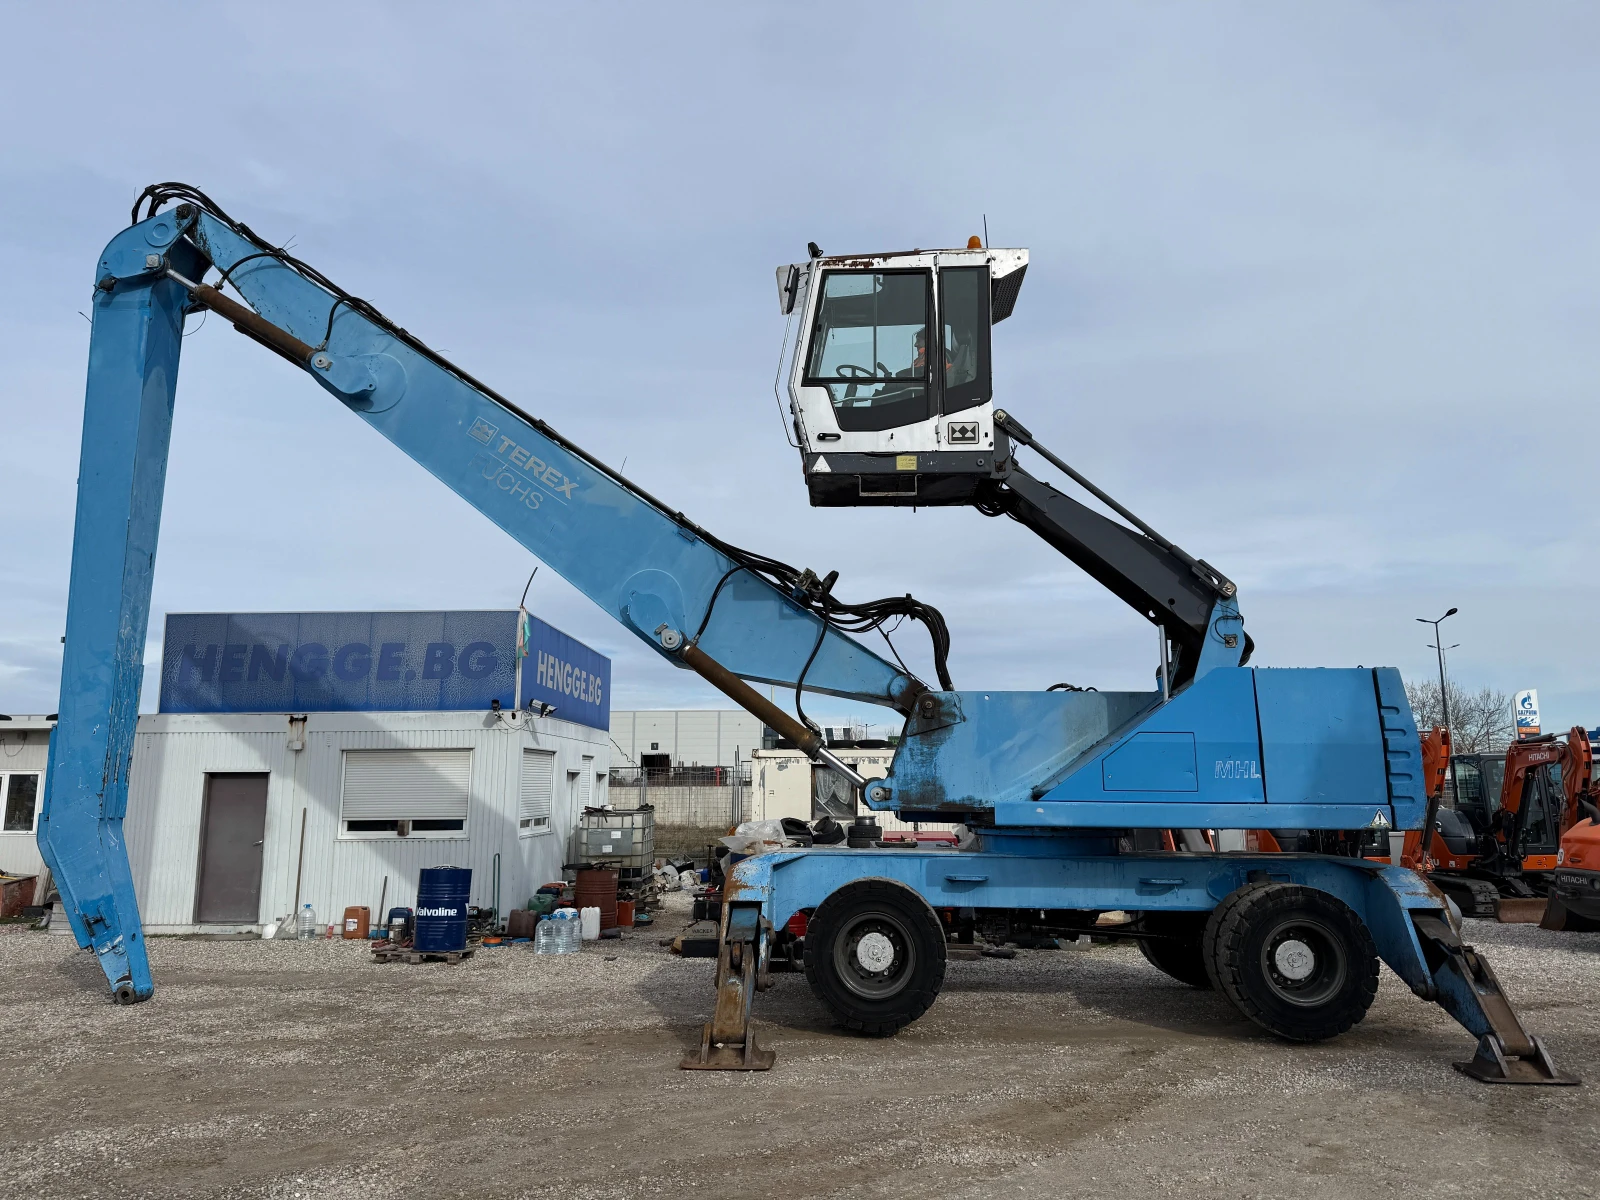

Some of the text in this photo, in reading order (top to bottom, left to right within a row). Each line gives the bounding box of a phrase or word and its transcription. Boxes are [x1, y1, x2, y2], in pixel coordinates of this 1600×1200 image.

[498, 435, 579, 500] TEREX
[178, 641, 498, 682] HENGGE.BG
[537, 649, 602, 706] HENGGE.BG
[1528, 751, 1550, 761] HITACHI
[1214, 760, 1261, 779] MHL
[1560, 874, 1588, 885] HITACHI
[416, 906, 458, 917] Valvoline
